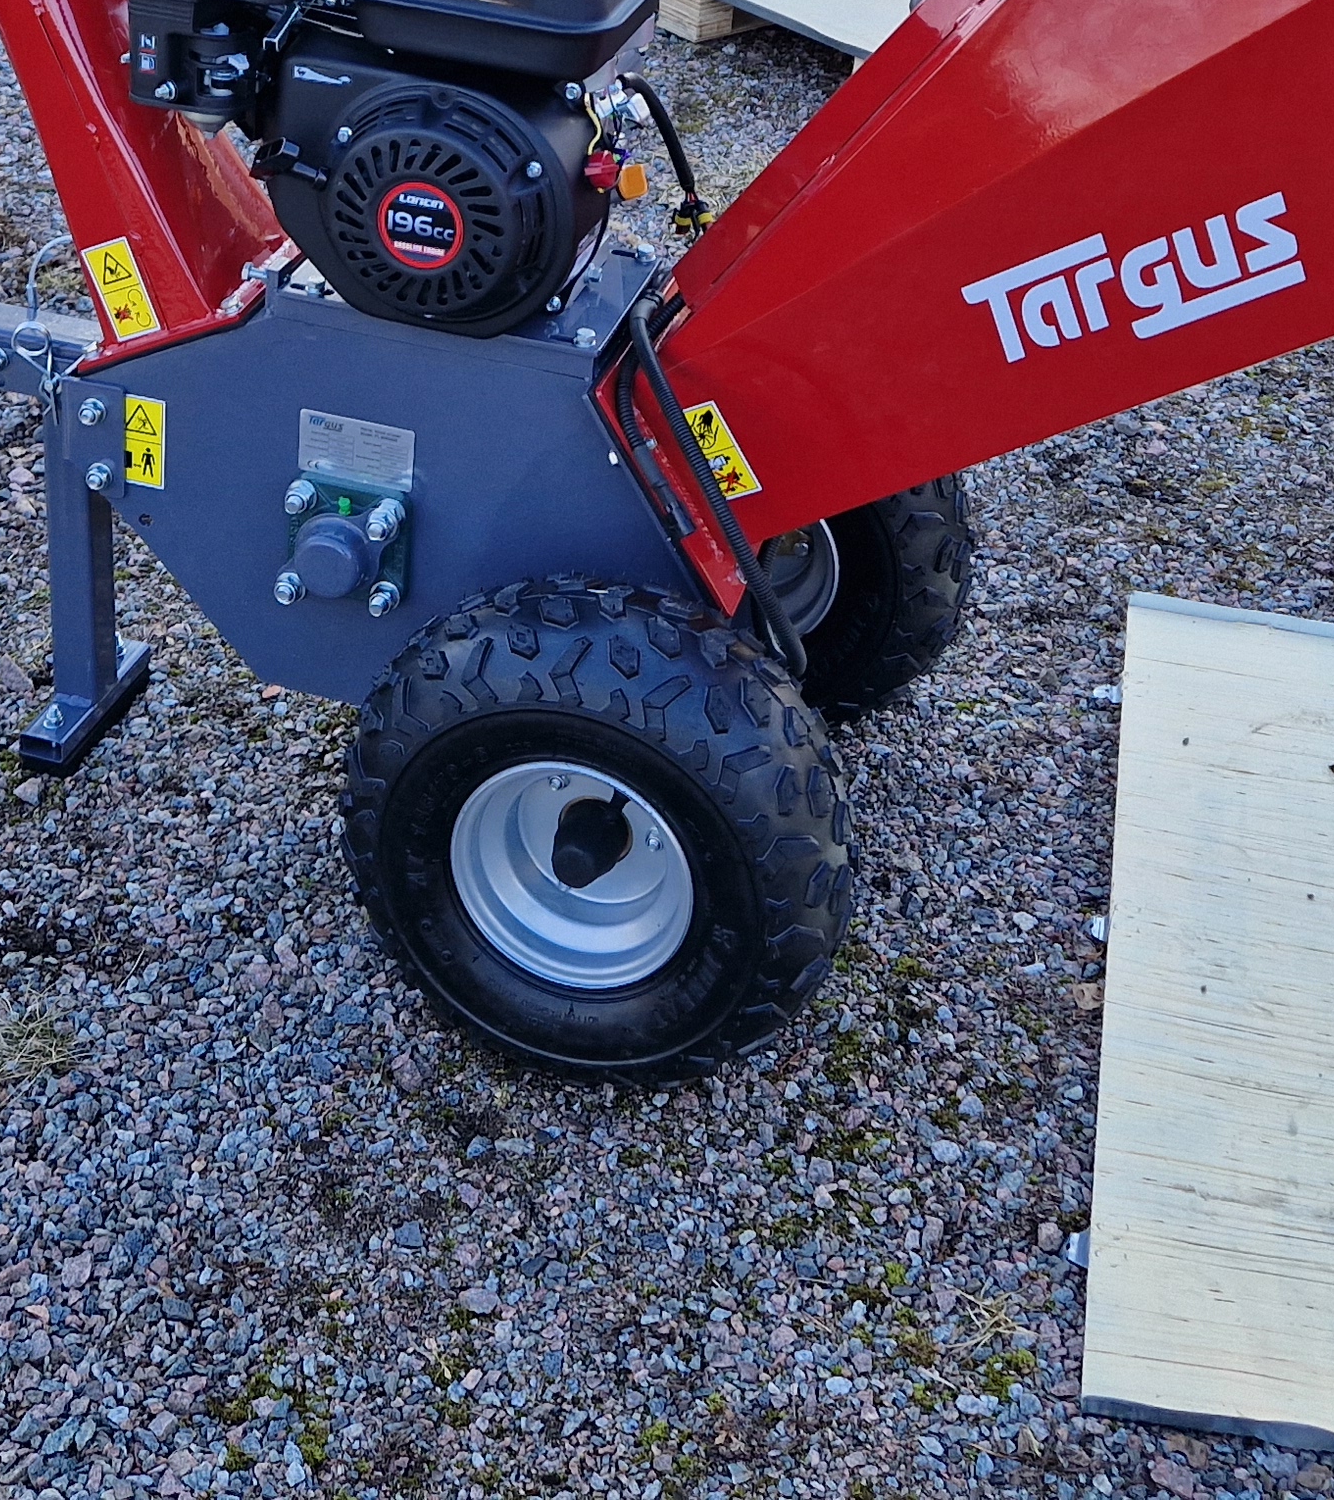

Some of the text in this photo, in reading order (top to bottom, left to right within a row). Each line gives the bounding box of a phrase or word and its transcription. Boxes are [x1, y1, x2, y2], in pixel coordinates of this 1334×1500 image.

[388, 209, 455, 241] 196cc
[960, 191, 1307, 363] Targus
[308, 414, 344, 433] Targus
